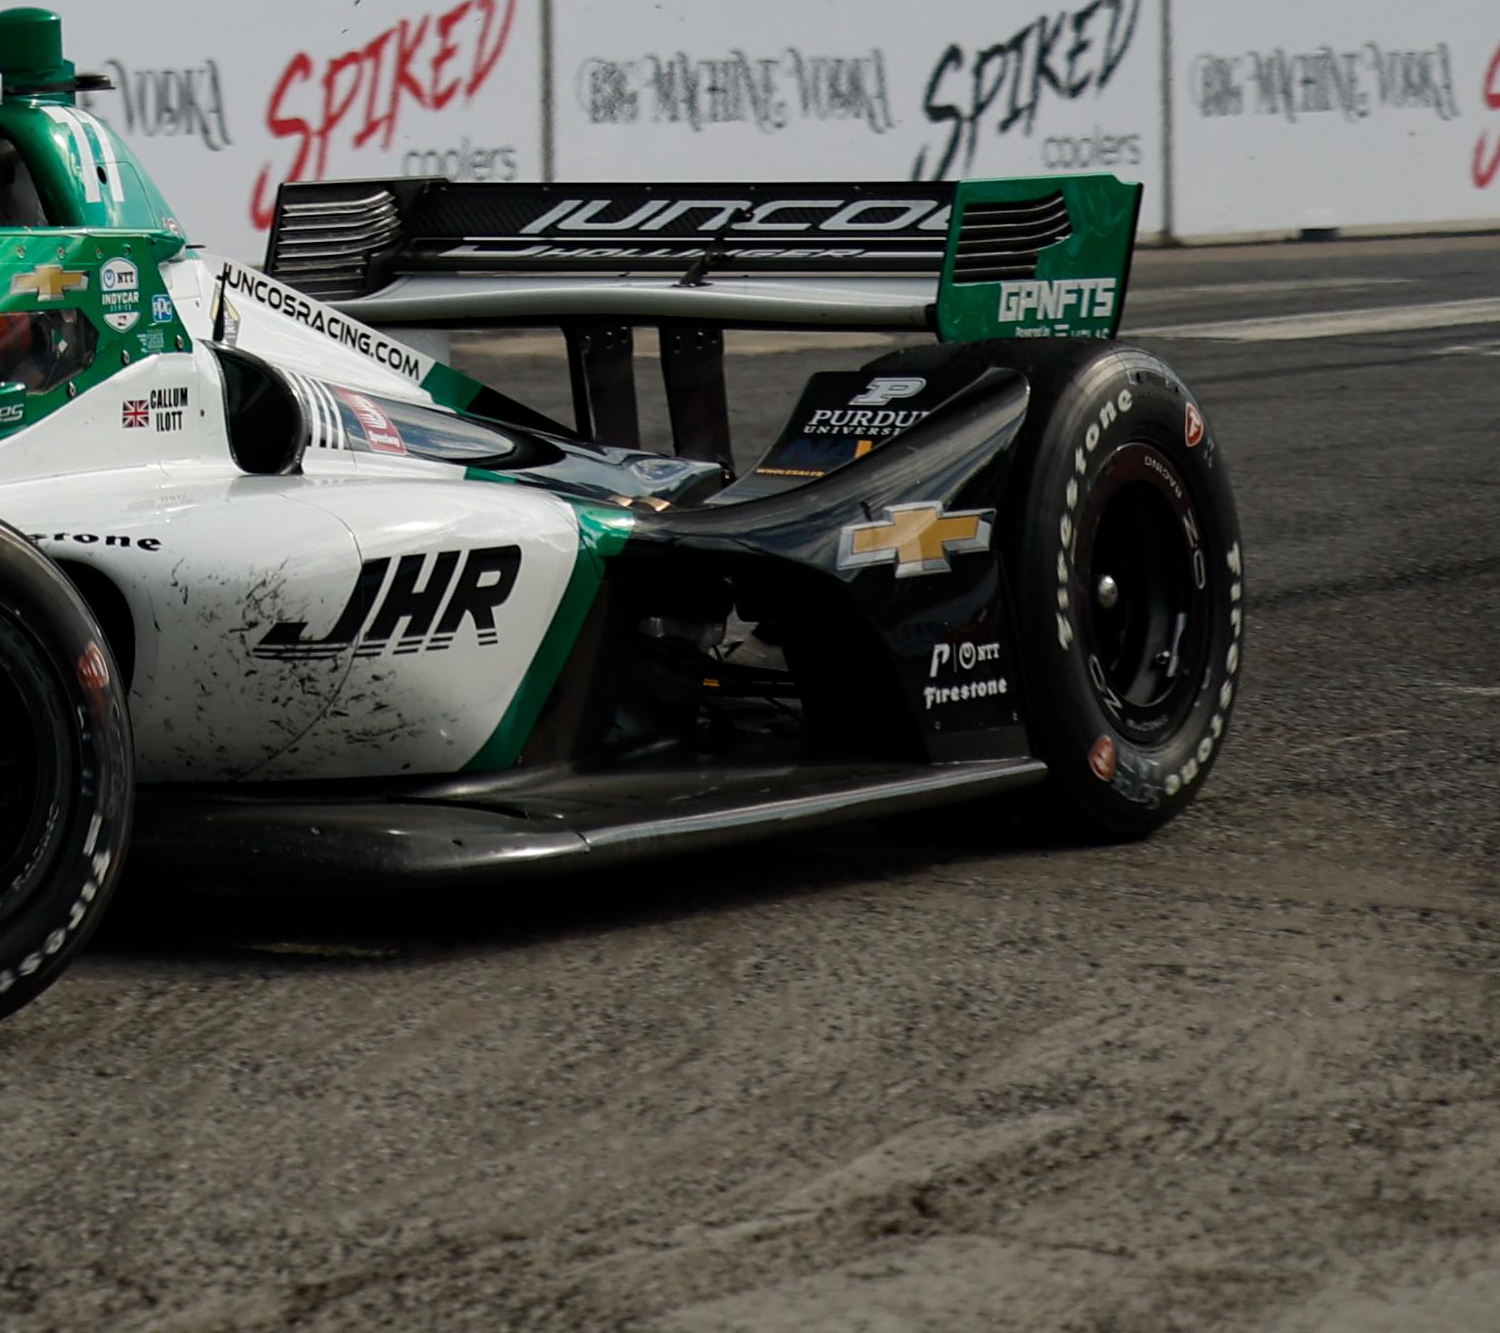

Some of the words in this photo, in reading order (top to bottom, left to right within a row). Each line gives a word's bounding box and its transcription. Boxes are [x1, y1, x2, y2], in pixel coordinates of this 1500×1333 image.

[106, 59, 233, 151] VODKA
[646, 47, 789, 130] MACHINE
[404, 137, 518, 182] coolers
[1042, 133, 1142, 167] coolers
[117, 271, 135, 284] NTT
[102, 291, 140, 305] INDYCAR
[152, 298, 174, 320] PPG
[998, 277, 1117, 322] GPNFTS
[150, 387, 189, 410] CALLUM
[156, 411, 184, 433] ILOTT
[1056, 387, 1133, 651] Firestone
[254, 544, 522, 661] JHR
[976, 642, 1001, 662] NTT
[1164, 541, 1245, 796] Firestone
[923, 677, 1008, 710] Firestone
